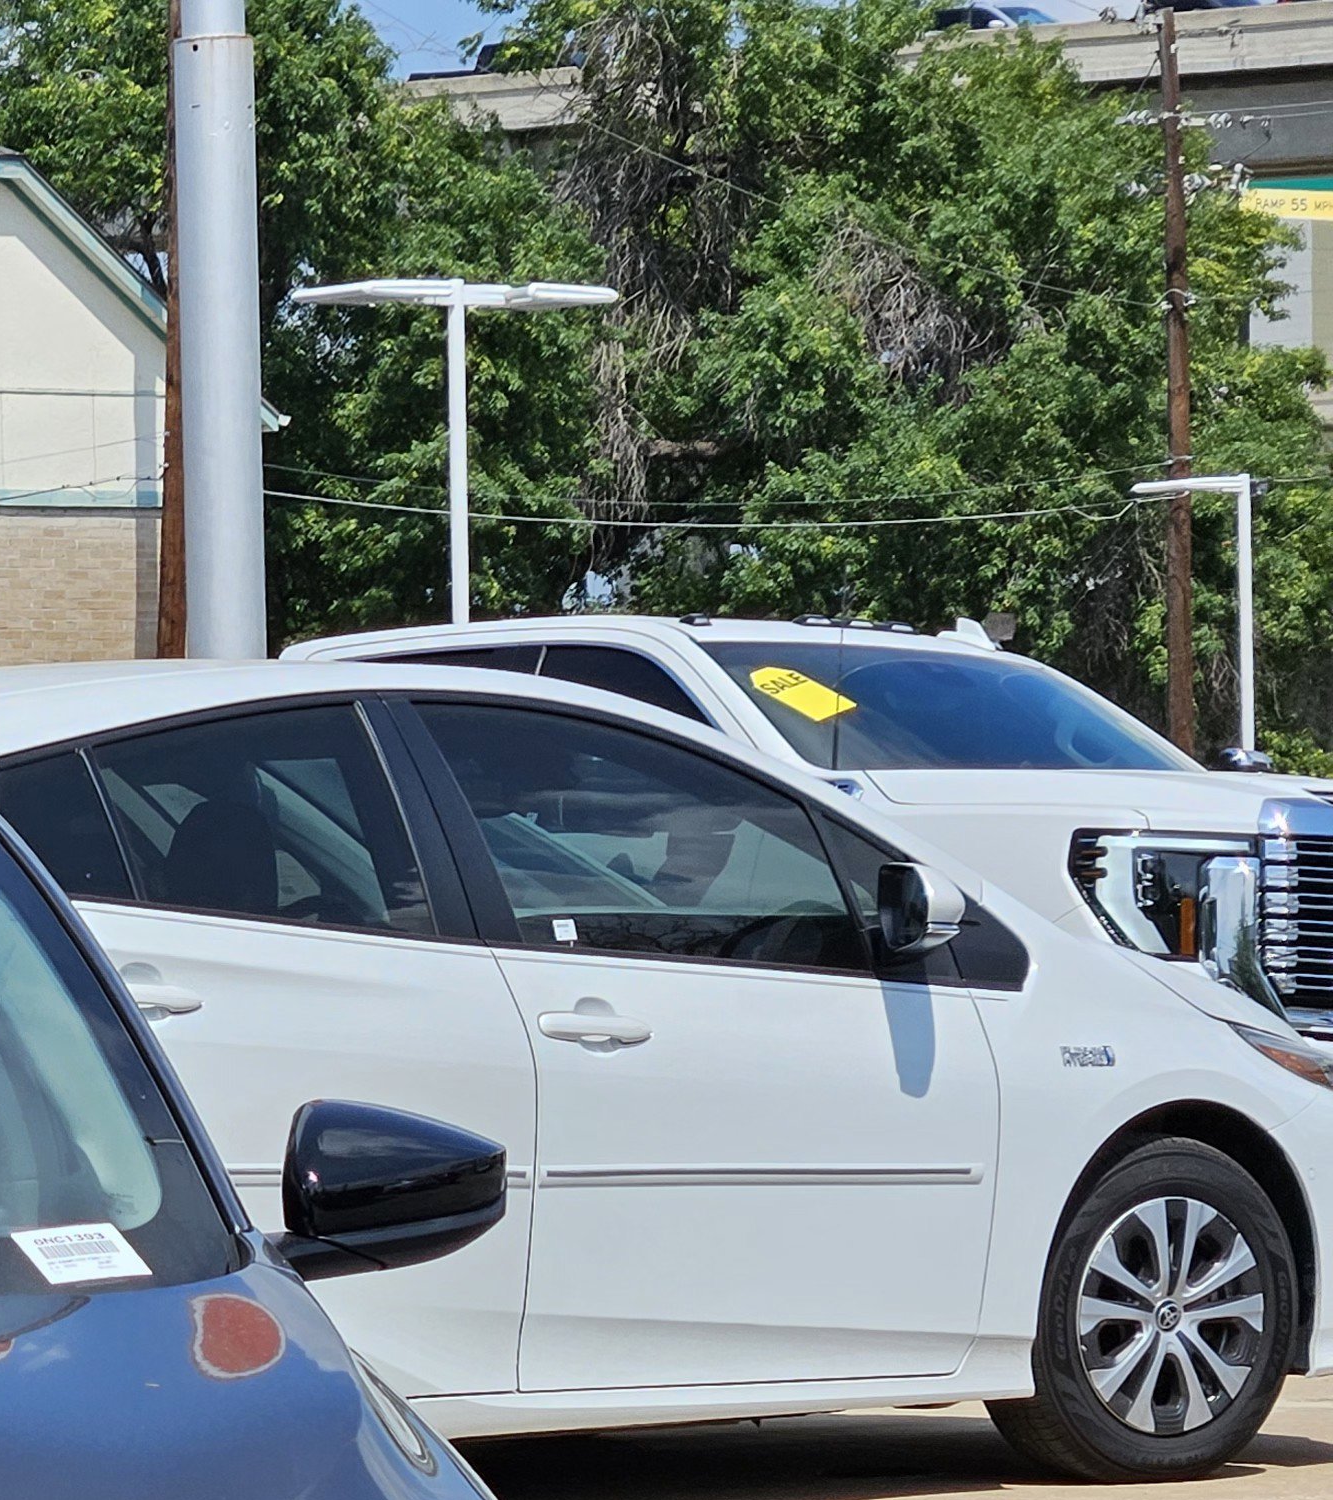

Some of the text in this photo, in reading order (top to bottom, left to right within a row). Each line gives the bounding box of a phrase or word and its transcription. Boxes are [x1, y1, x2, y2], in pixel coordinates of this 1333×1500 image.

[1255, 198, 1286, 210] RAMP
[1291, 198, 1308, 212] 55
[760, 673, 810, 695] SALE
